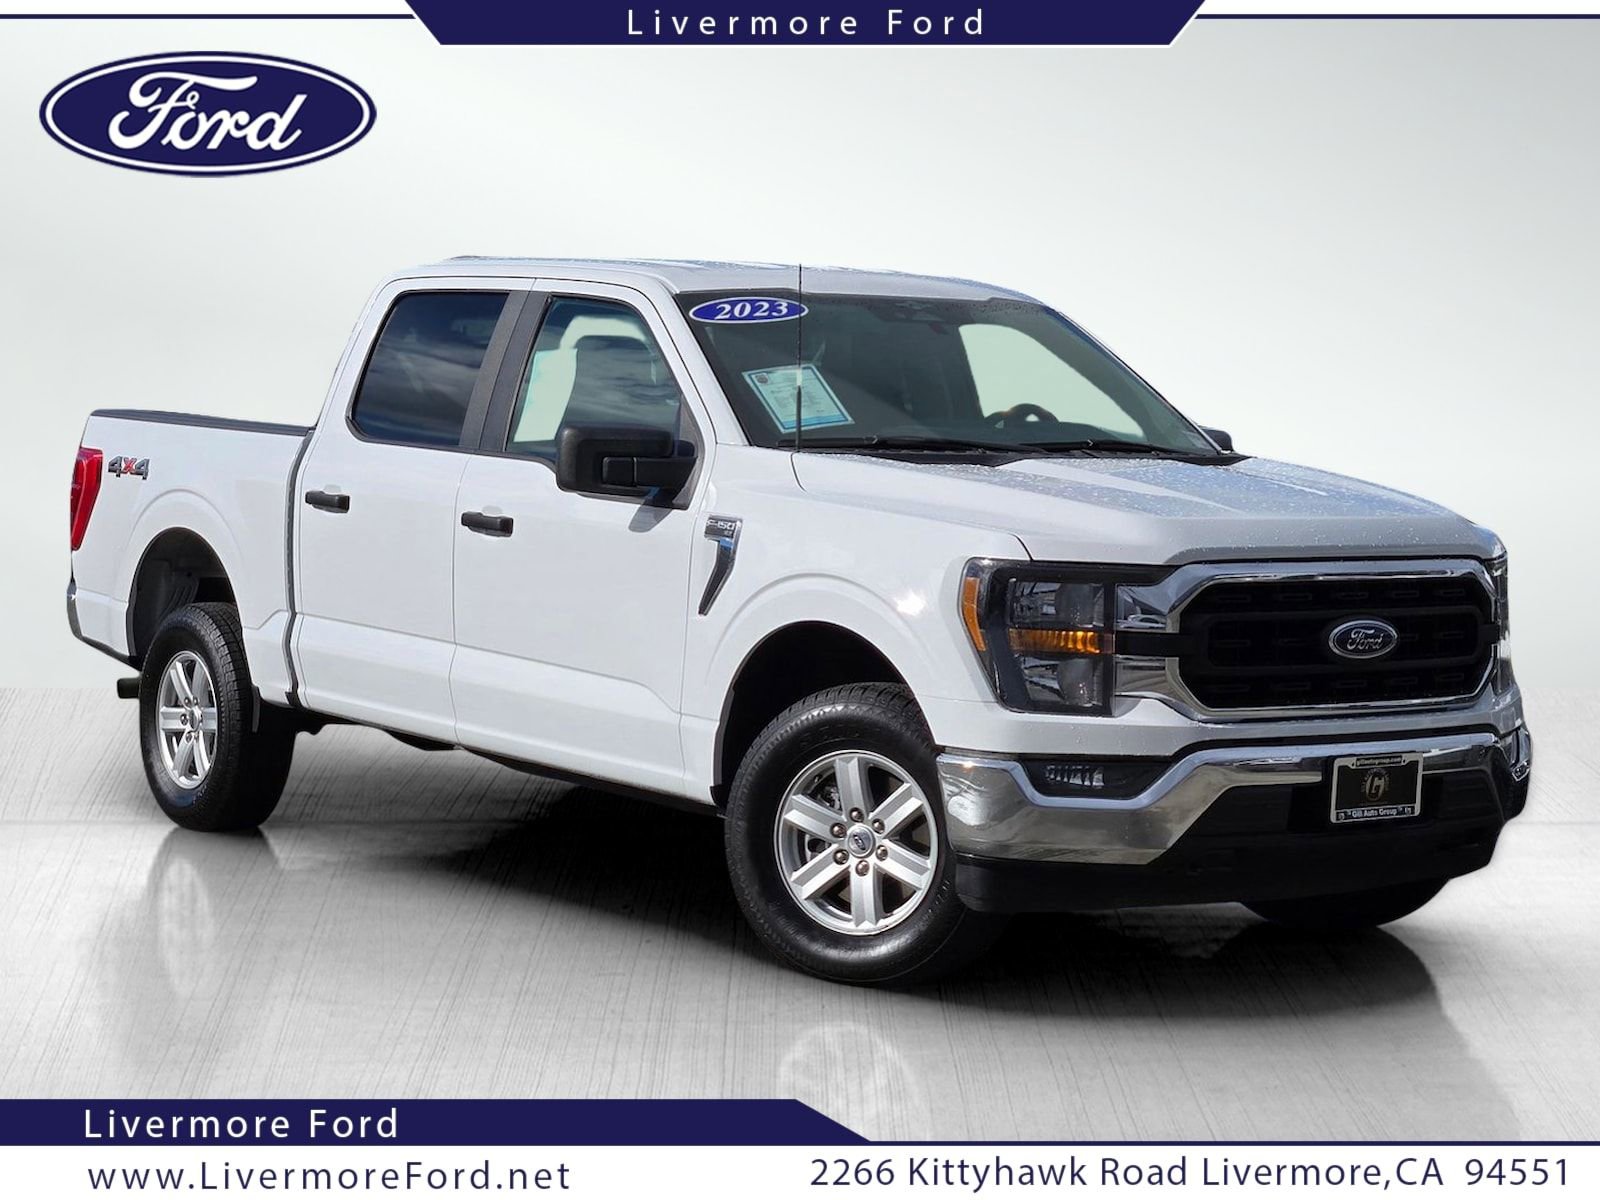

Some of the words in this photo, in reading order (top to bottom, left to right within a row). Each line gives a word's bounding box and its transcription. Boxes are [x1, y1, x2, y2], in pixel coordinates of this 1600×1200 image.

[714, 301, 789, 320] 2023
[1346, 628, 1384, 650] Ford
[1379, 808, 1398, 816] Group
